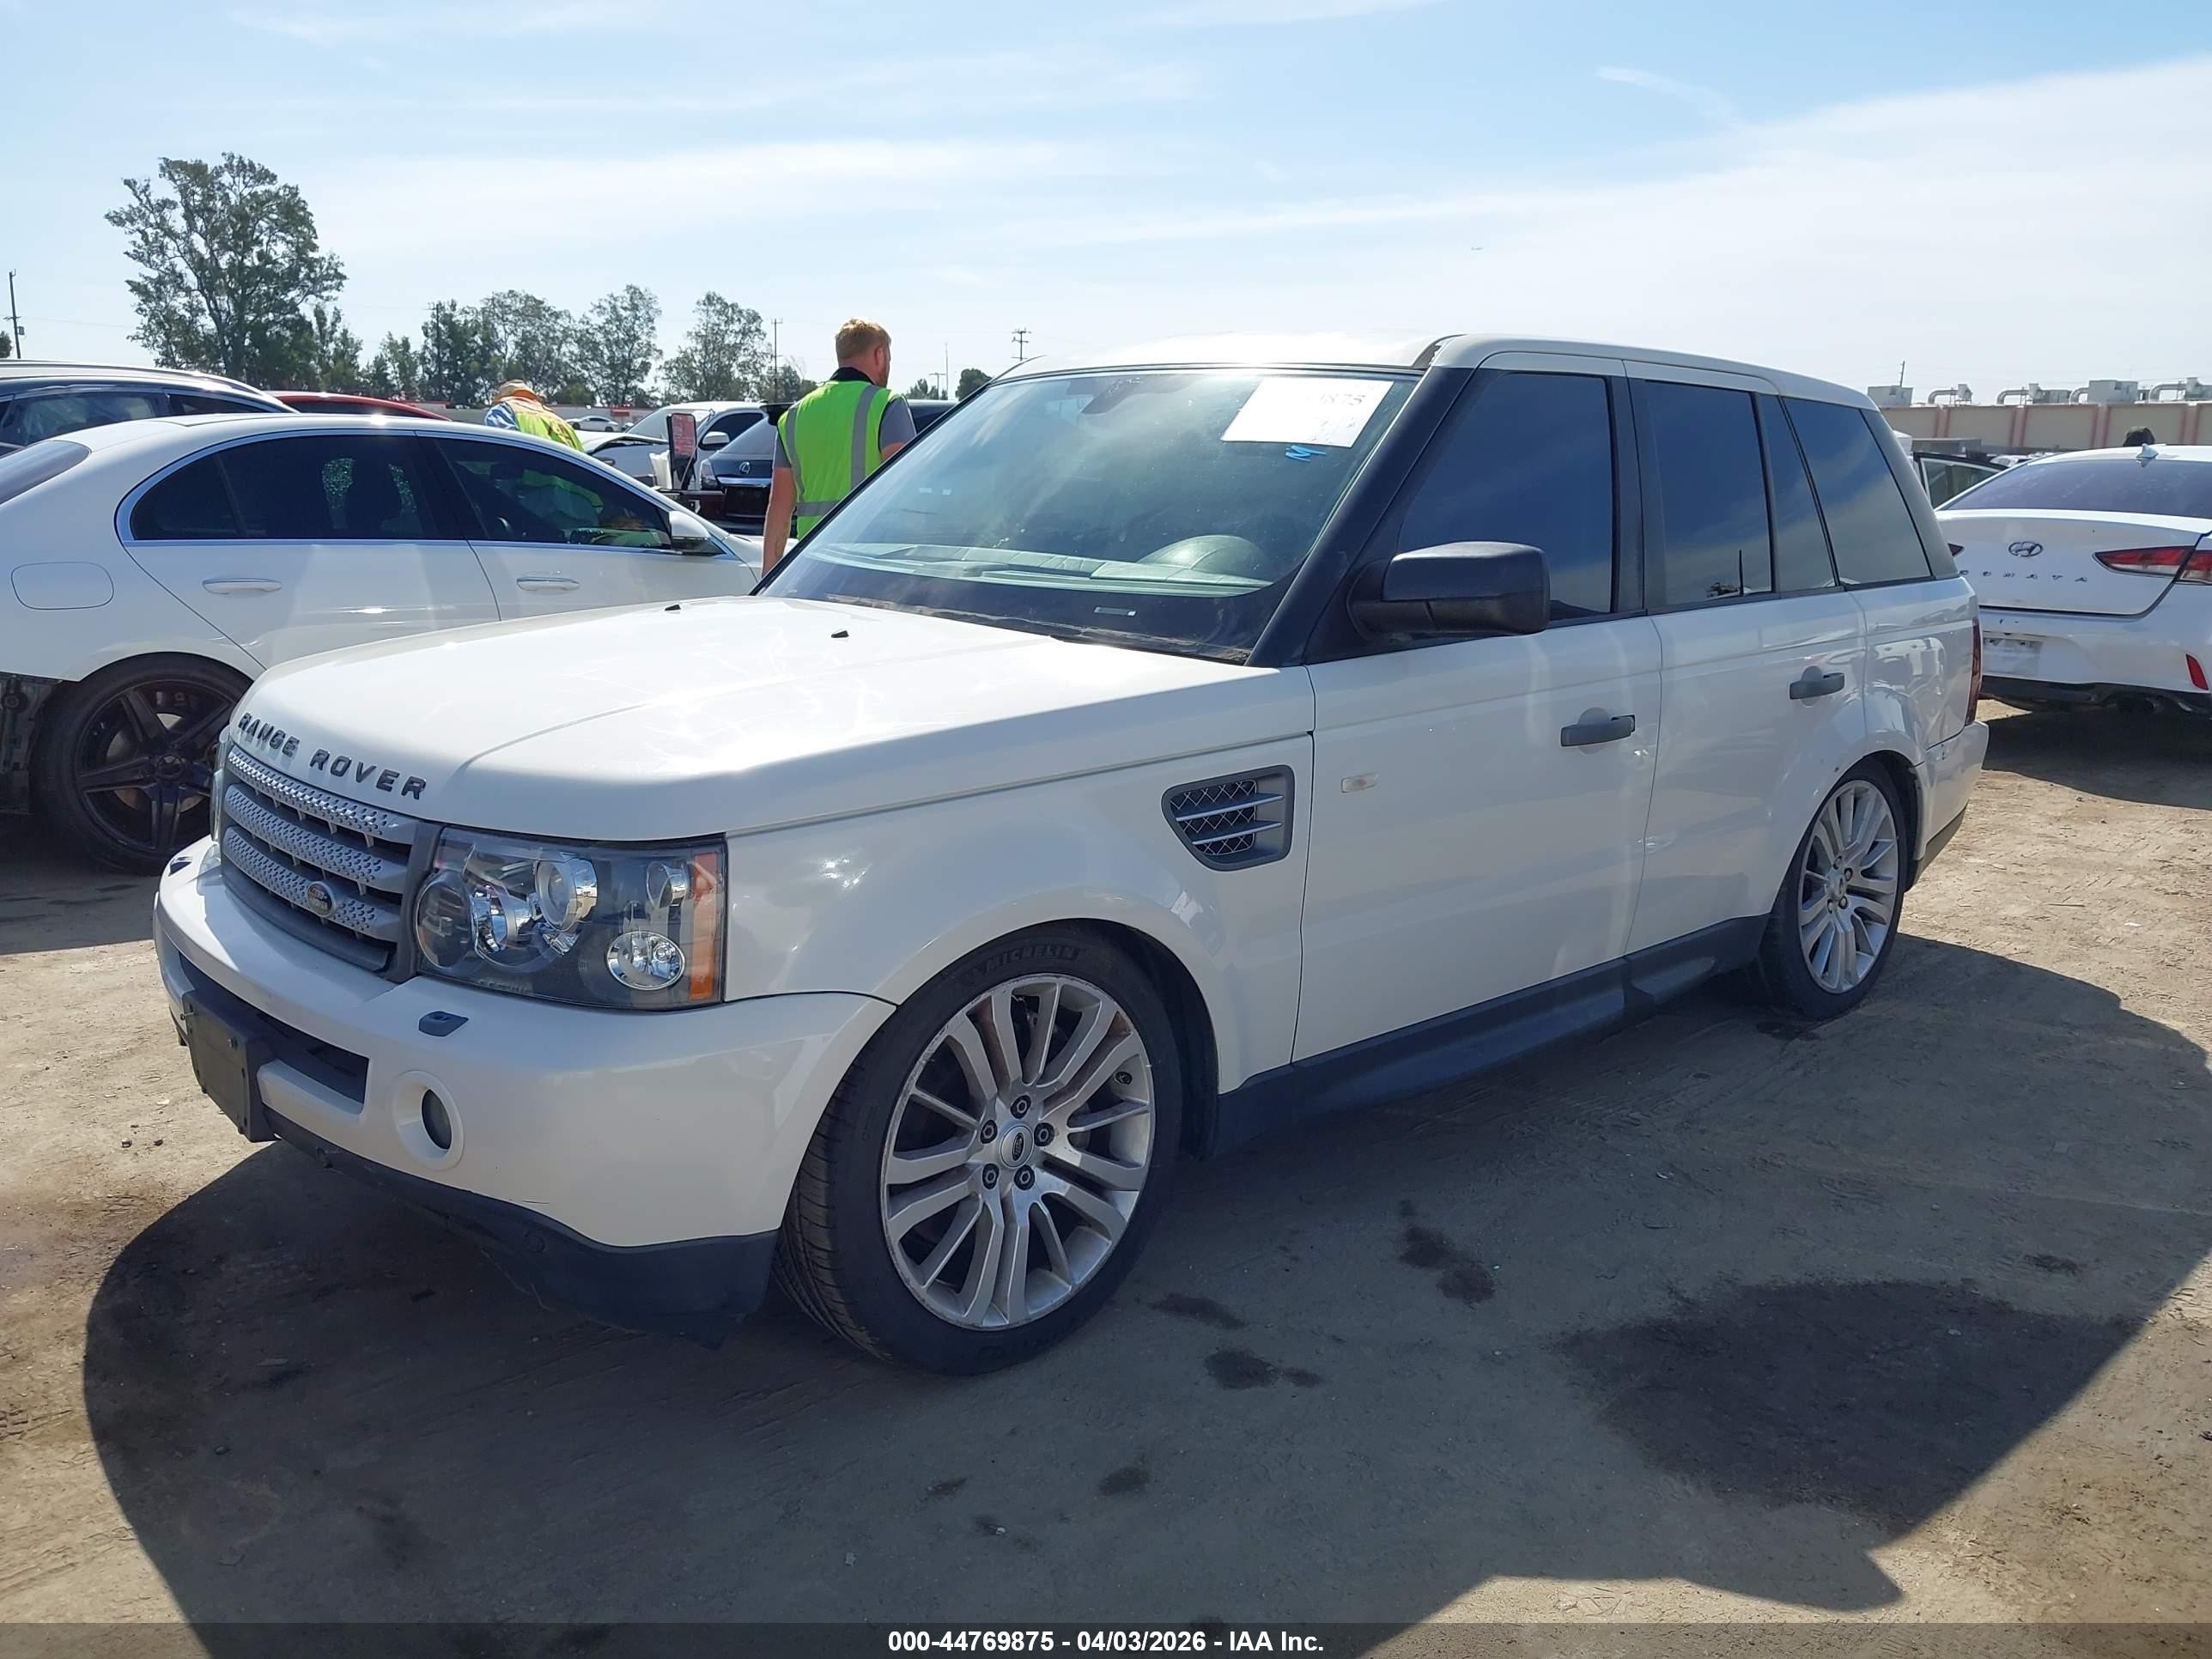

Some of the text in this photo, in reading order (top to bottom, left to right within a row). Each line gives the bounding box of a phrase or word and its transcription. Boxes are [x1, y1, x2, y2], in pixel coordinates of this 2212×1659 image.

[238, 712, 427, 799] RANGE ROVER
[986, 944, 1080, 972] MICHELIN
